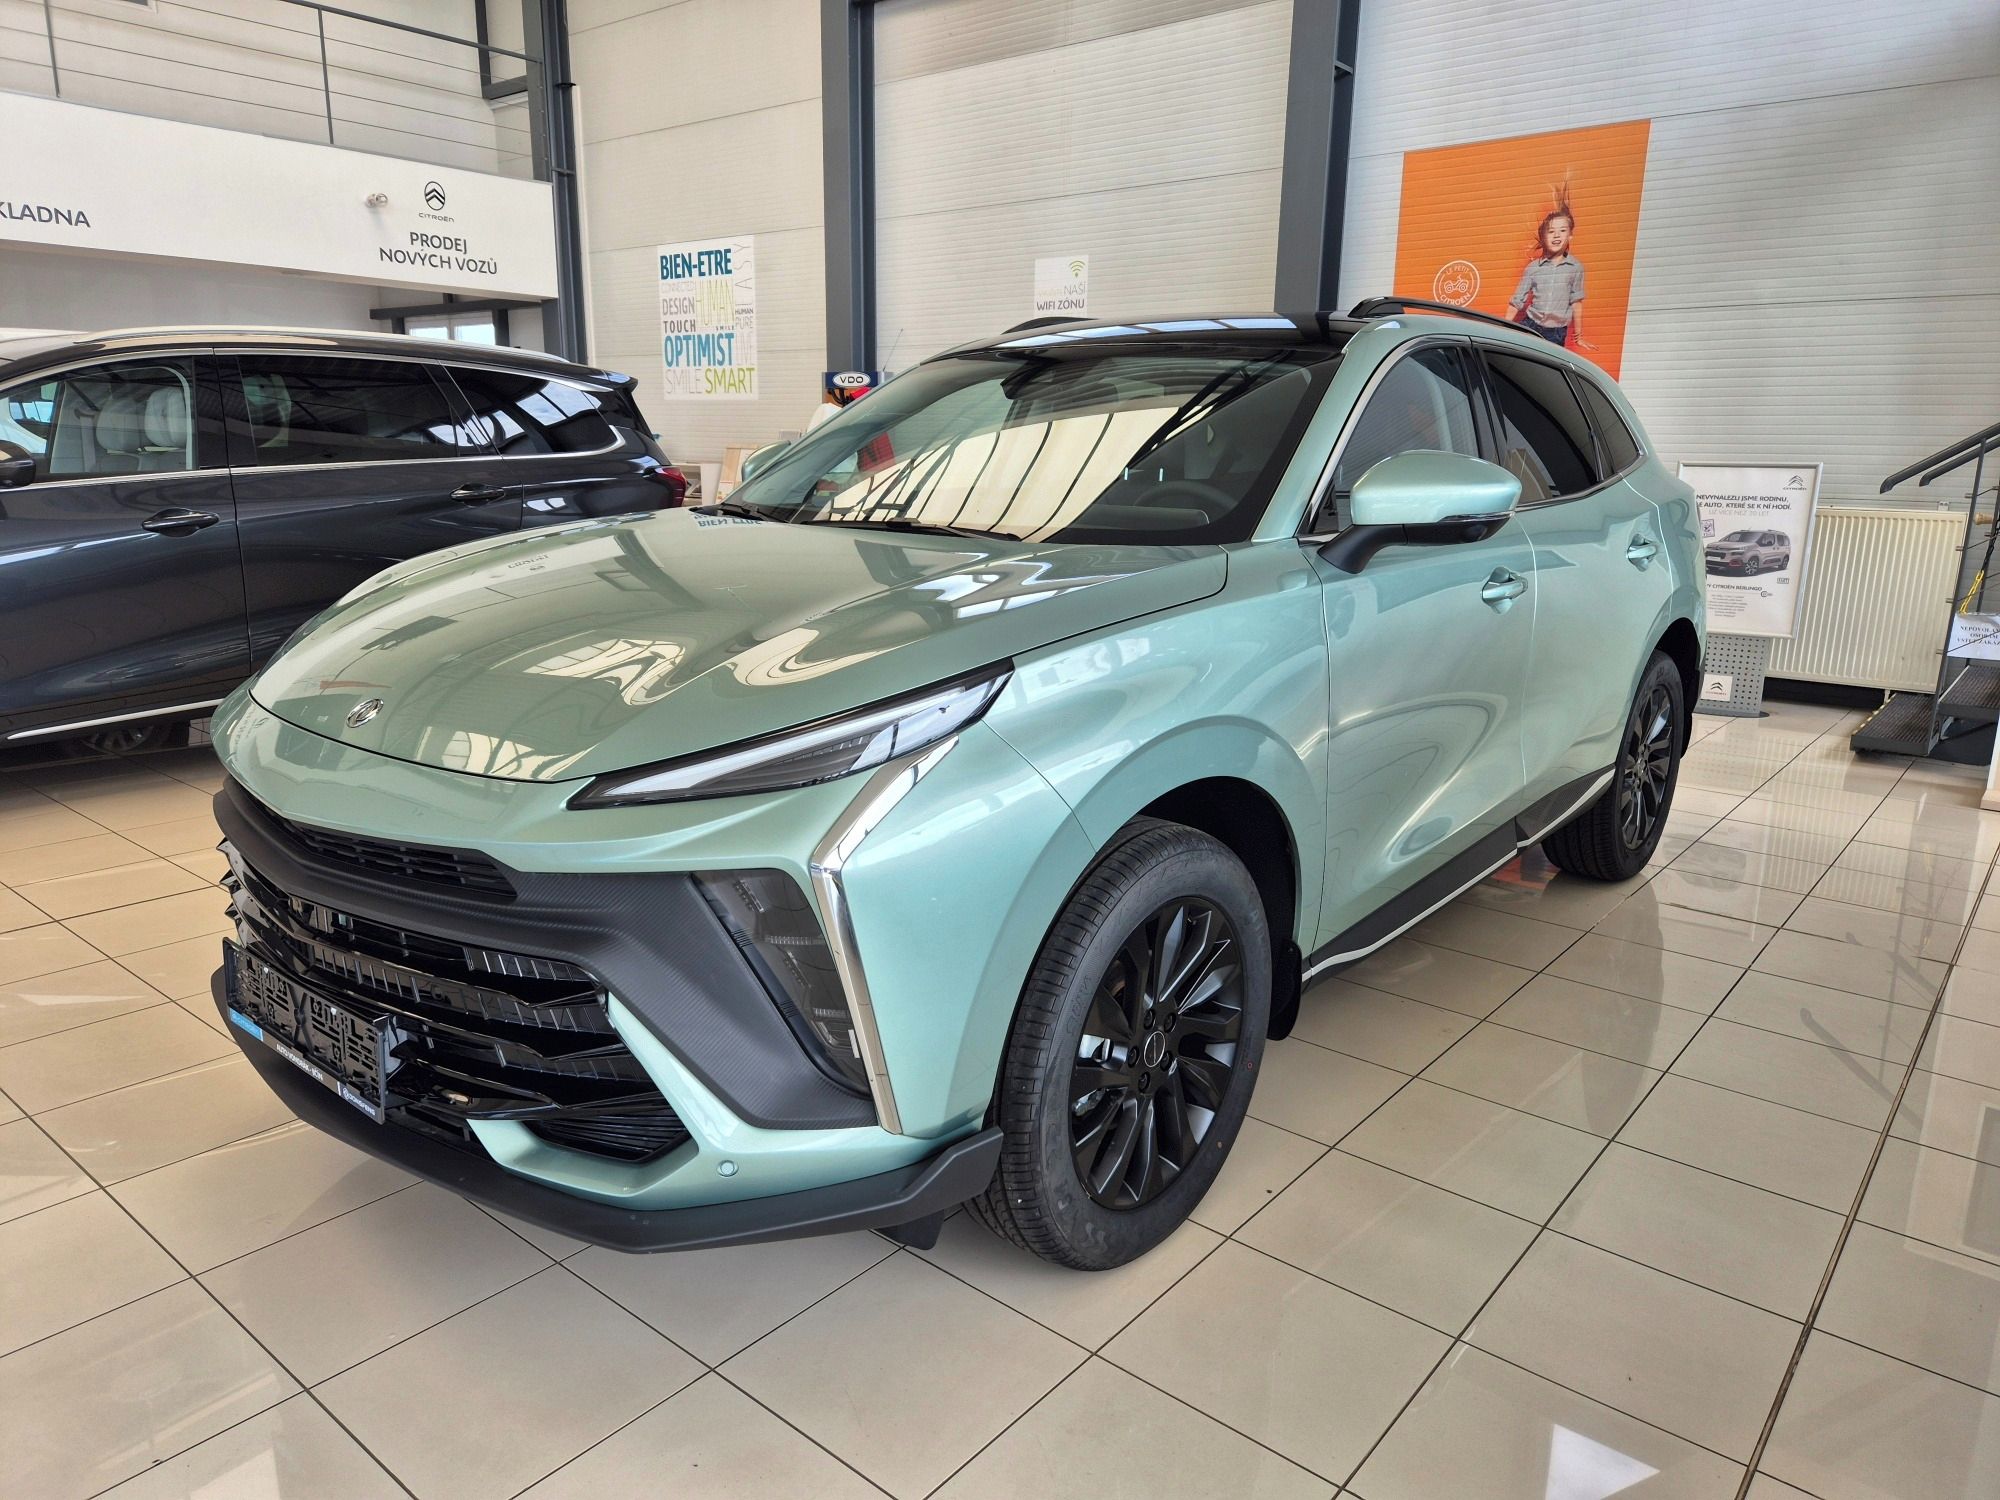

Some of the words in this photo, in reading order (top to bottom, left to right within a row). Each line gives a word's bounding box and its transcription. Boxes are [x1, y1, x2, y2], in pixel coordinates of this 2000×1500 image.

[409, 231, 467, 255] PRODEJ
[379, 247, 452, 270] NOVÝCH
[455, 257, 498, 275] VOZŮ
[660, 249, 732, 280] BIEN-ETRE
[662, 297, 696, 316] DESIGN
[735, 308, 754, 316] HUMAN
[1036, 300, 1056, 311] WIFI
[1057, 297, 1085, 310] ZÓNU
[663, 319, 697, 334] TOUCH
[664, 332, 735, 368] OPTIMIST
[665, 368, 703, 395] SMILE
[704, 367, 756, 394] SMART
[840, 376, 864, 384] VDO
